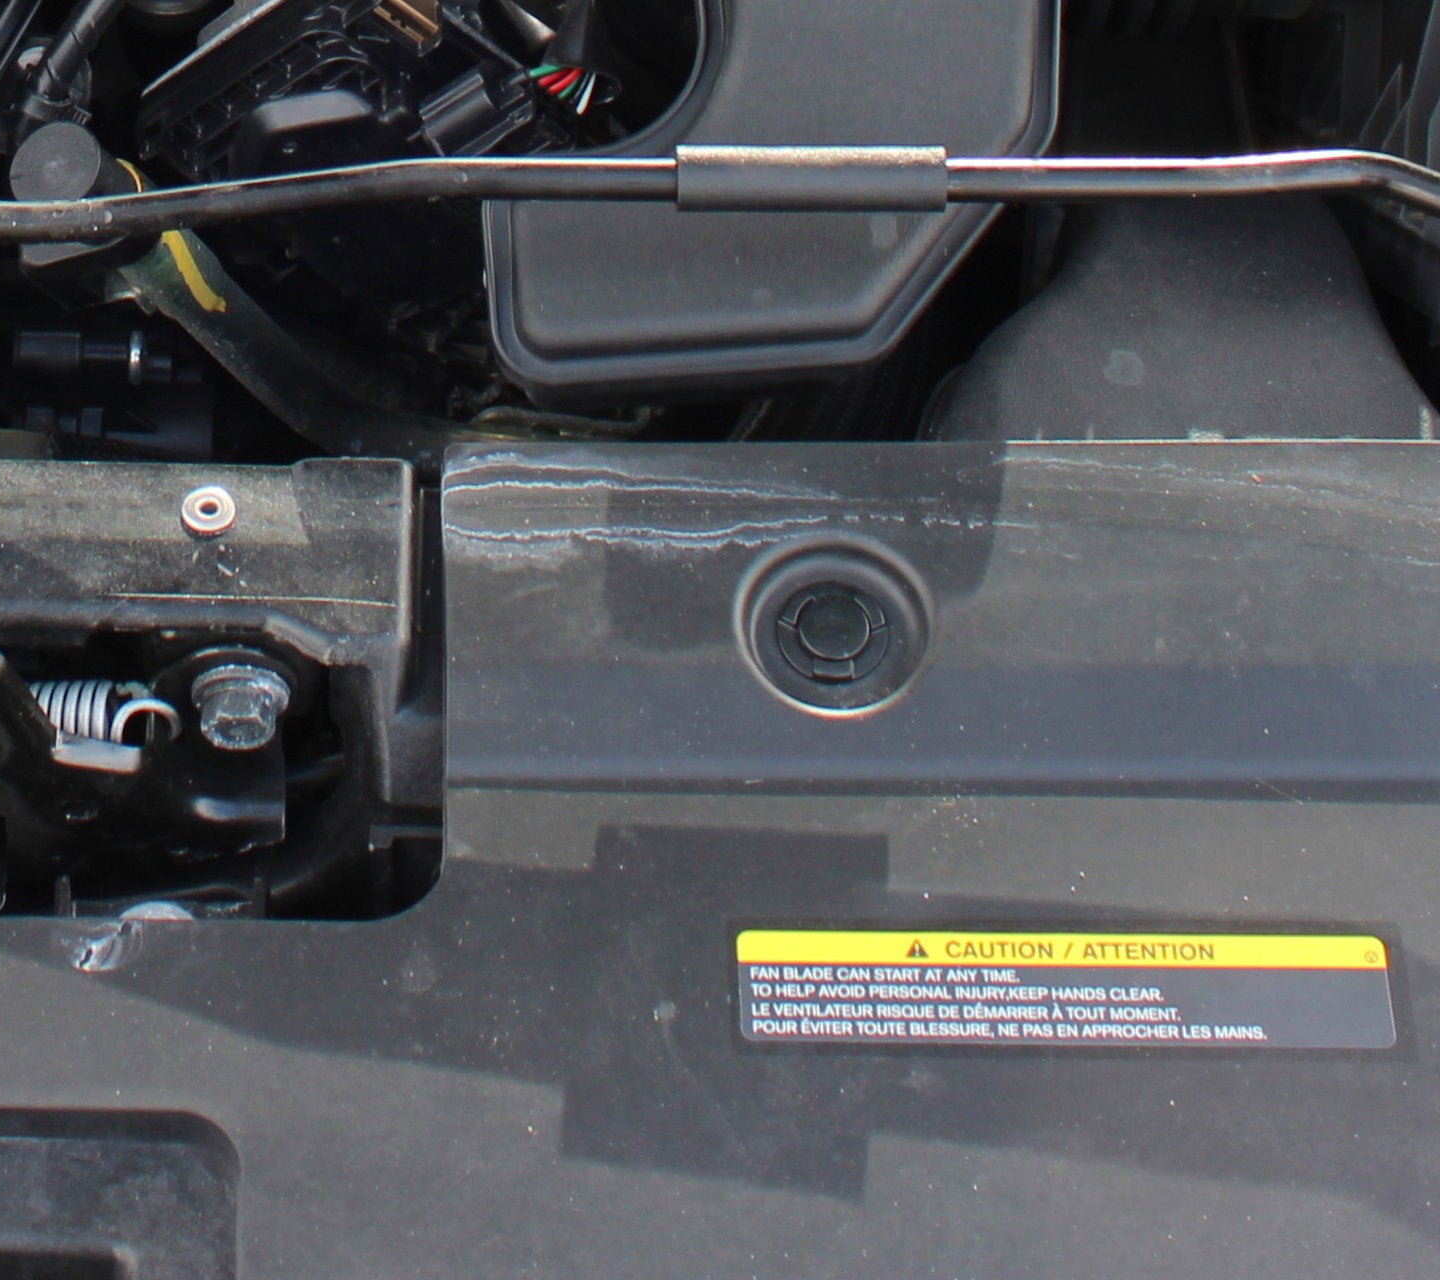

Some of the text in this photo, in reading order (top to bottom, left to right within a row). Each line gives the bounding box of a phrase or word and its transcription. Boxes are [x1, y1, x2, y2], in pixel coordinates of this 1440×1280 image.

[945, 940, 1054, 960] CAUTION
[1082, 941, 1215, 961] ATTENTION
[750, 966, 1021, 983] FAN BLADE CAN START AT ANY TIME.
[750, 983, 771, 997] TO
[776, 983, 816, 998] HELP
[819, 984, 865, 999] AVOID
[870, 985, 952, 1000] PERSONAL
[1052, 986, 1106, 1001] HANDS
[1110, 987, 1165, 1002] CLEAR.
[752, 1002, 1181, 1021] LE VENTILATEUR RISQUE DE DÉMARRER À TOUT MOMENT.
[753, 1017, 1268, 1040] POUR ÉVITER TOUTE BLESSURE, NE PAS EN APPROCHER LES MAINS.
